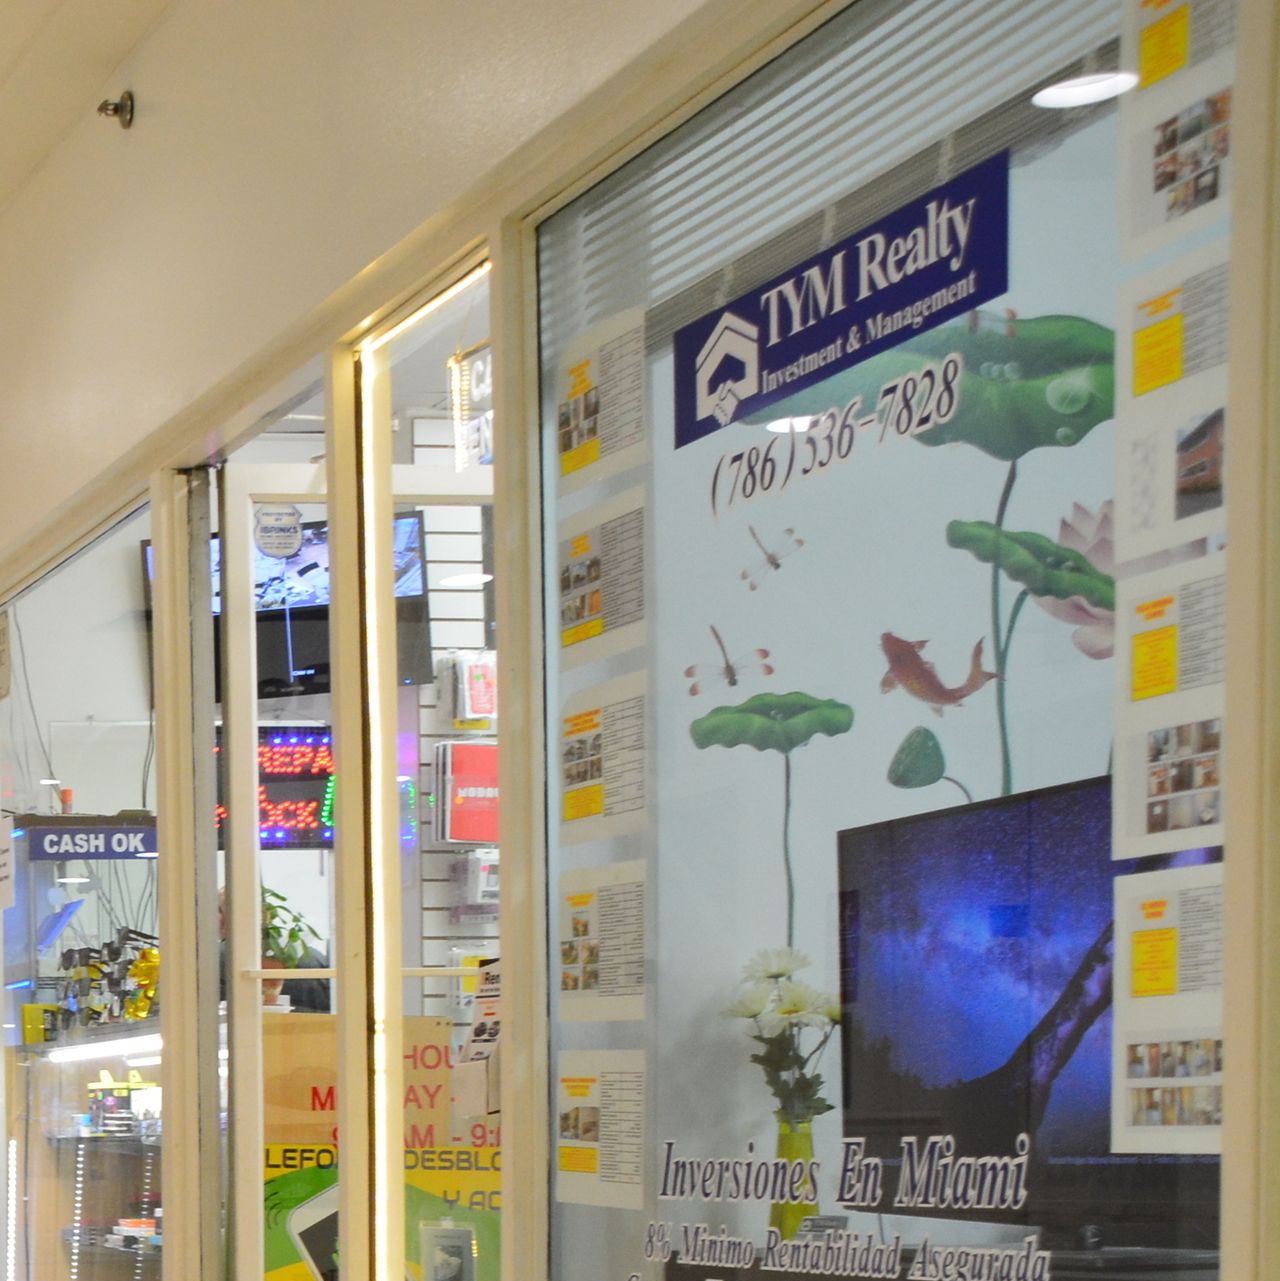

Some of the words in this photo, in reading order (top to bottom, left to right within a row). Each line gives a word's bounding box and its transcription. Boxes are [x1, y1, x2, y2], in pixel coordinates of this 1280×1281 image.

[760, 250, 847, 348] TYM
[855, 198, 976, 302] Realty
[761, 339, 842, 394] Investment
[846, 324, 862, 353] &
[865, 269, 977, 344] Management
[43, 833, 105, 854] CASH
[111, 833, 145, 853] OK
[659, 1140, 821, 1202] Inversiones
[835, 1137, 882, 1207] En
[894, 1132, 1030, 1210] Miami
[645, 1221, 673, 1262] 8%
[760, 1227, 901, 1279] Rentabilidad
